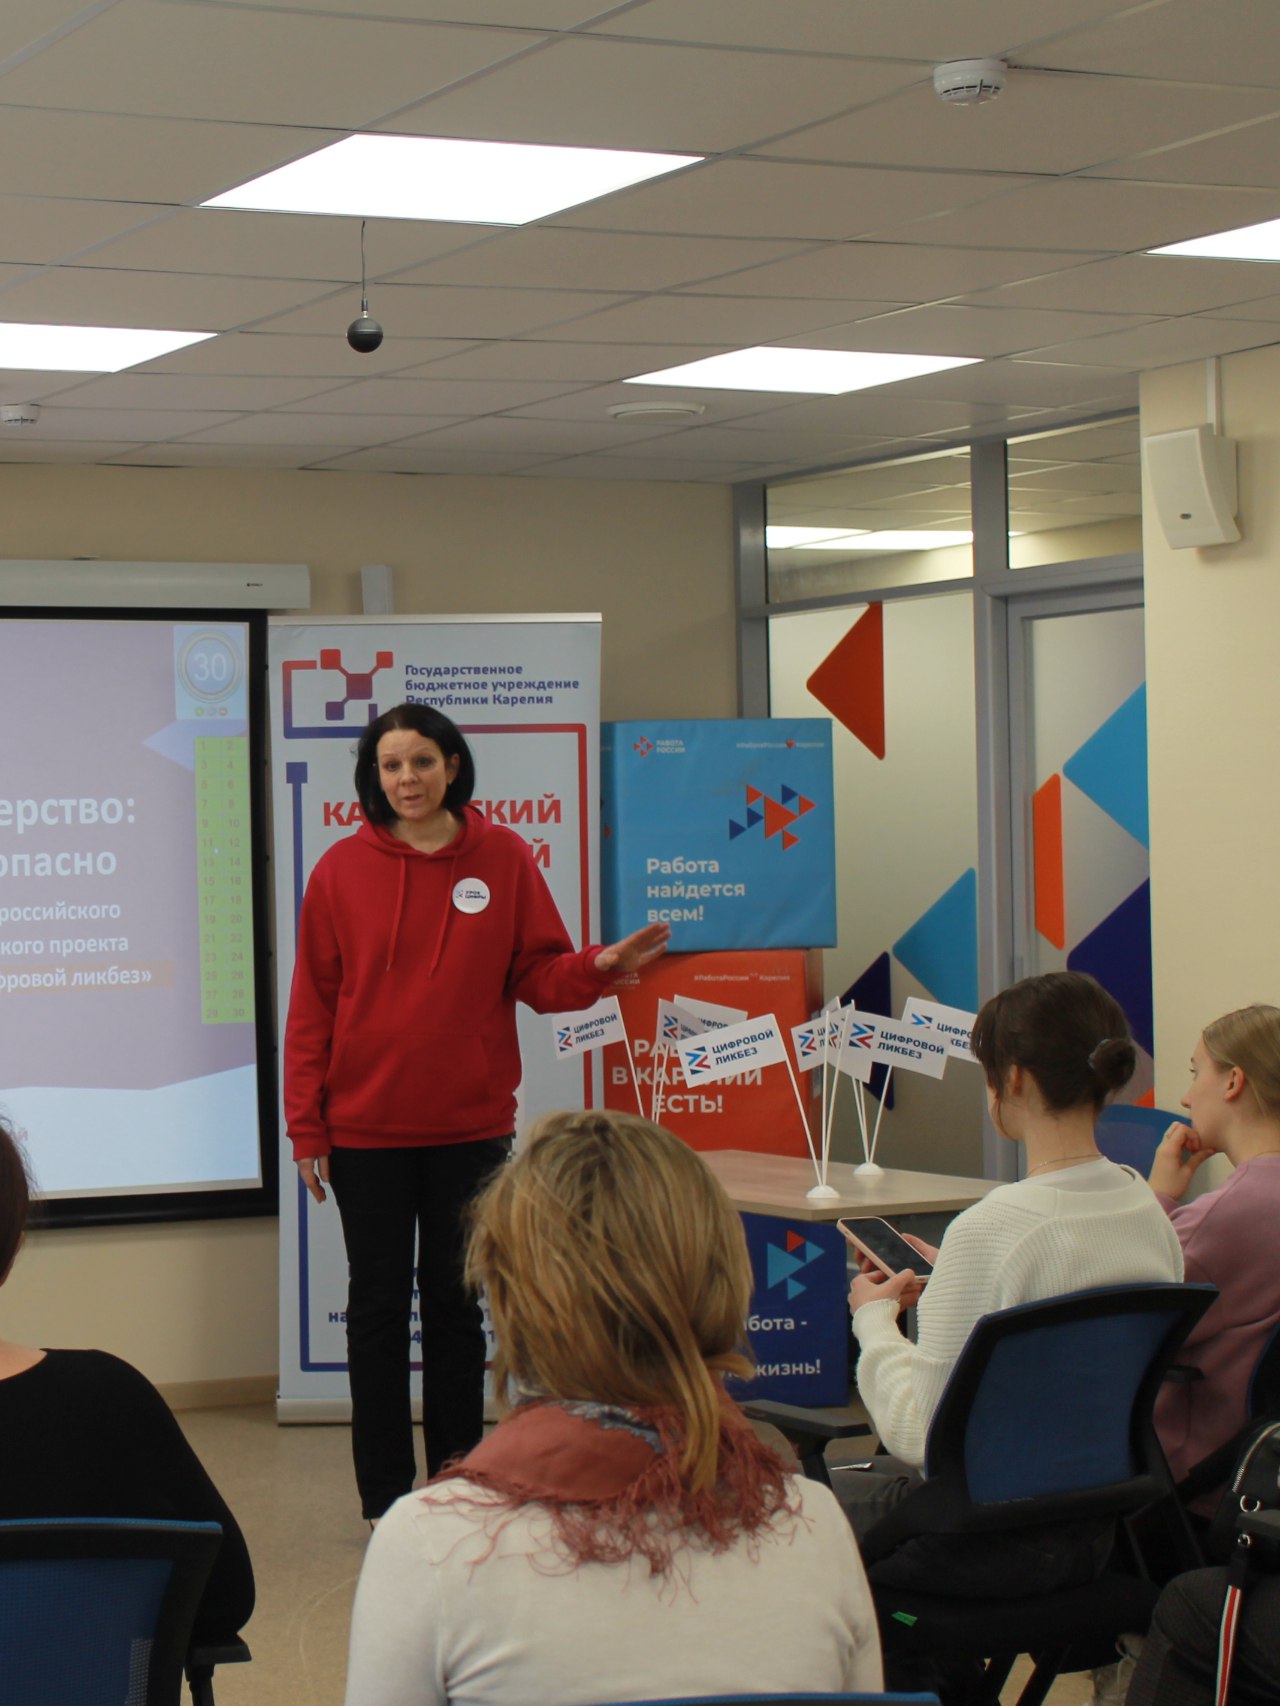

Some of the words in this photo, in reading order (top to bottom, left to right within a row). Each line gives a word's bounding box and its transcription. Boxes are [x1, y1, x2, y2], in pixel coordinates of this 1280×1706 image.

[193, 652, 227, 681] 30
[405, 664, 523, 677] Государственное
[405, 679, 488, 692] бюджетное
[491, 679, 580, 693] учреждение
[406, 694, 488, 707] Республики
[493, 694, 553, 707] Карелия
[646, 856, 720, 874] Работа
[647, 881, 745, 899] найдется
[647, 905, 704, 922] всем!
[49, 936, 129, 957] проекта
[71, 966, 152, 987] ликбез»
[573, 1013, 618, 1034] ЦИФРОВОЙ
[575, 1029, 605, 1044] ЛИКБЕЗ
[712, 1030, 774, 1054] ЦИФРОВОЙ
[880, 1030, 945, 1055] ЦИФРОВОЙ
[715, 1047, 758, 1066] ЛИКБЕЗ
[877, 1042, 922, 1059] ЛИКБЕЗ
[612, 1067, 628, 1085] В
[654, 1094, 723, 1114] ЕСТЬ!
